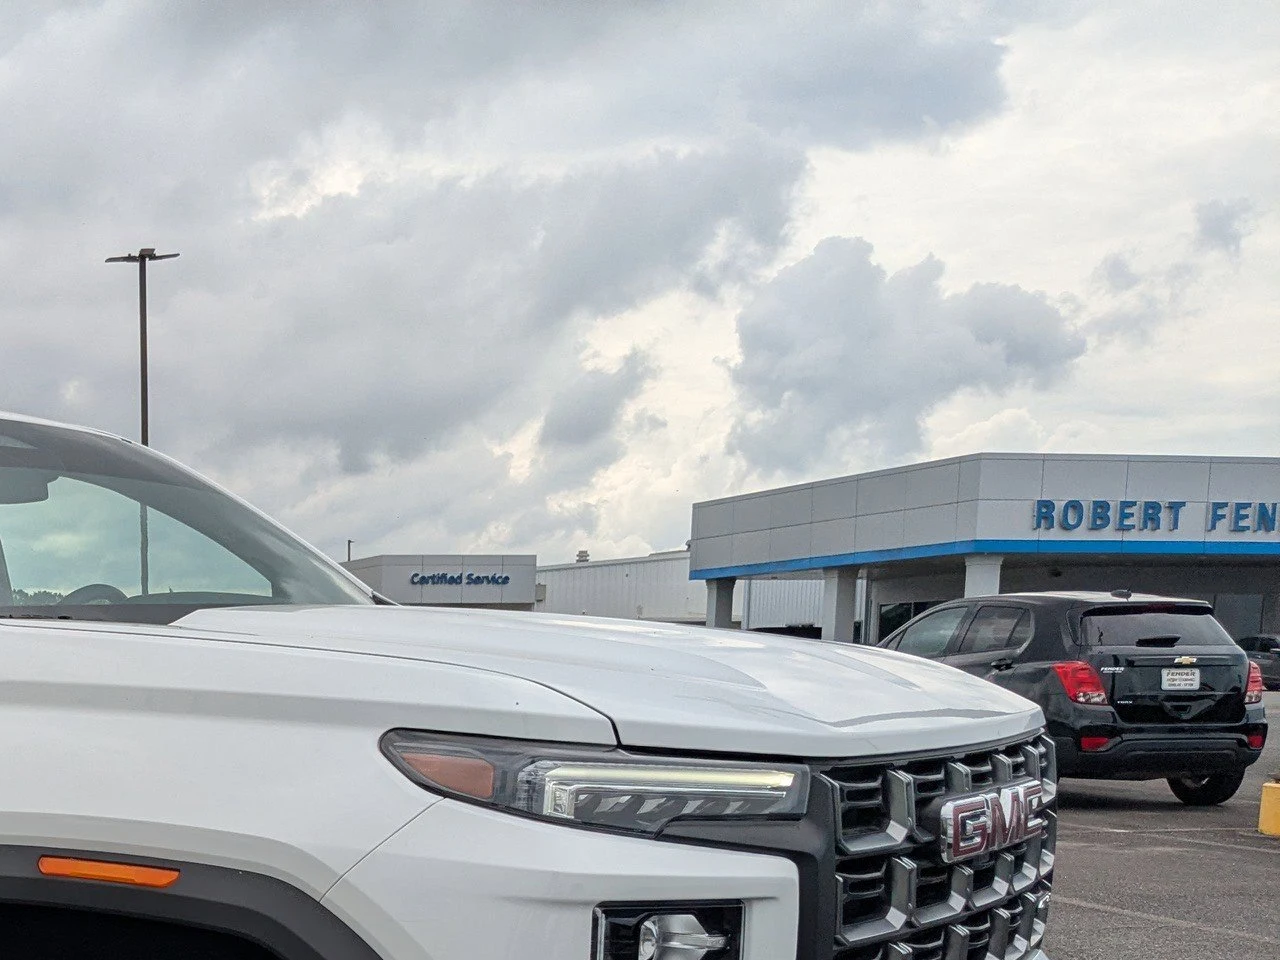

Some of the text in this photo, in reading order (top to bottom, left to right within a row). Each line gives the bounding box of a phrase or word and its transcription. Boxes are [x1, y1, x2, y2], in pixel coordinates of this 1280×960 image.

[1034, 499, 1278, 532] ROBERT FEN
[410, 572, 510, 585] Certified Service
[940, 780, 1046, 864] GMC
